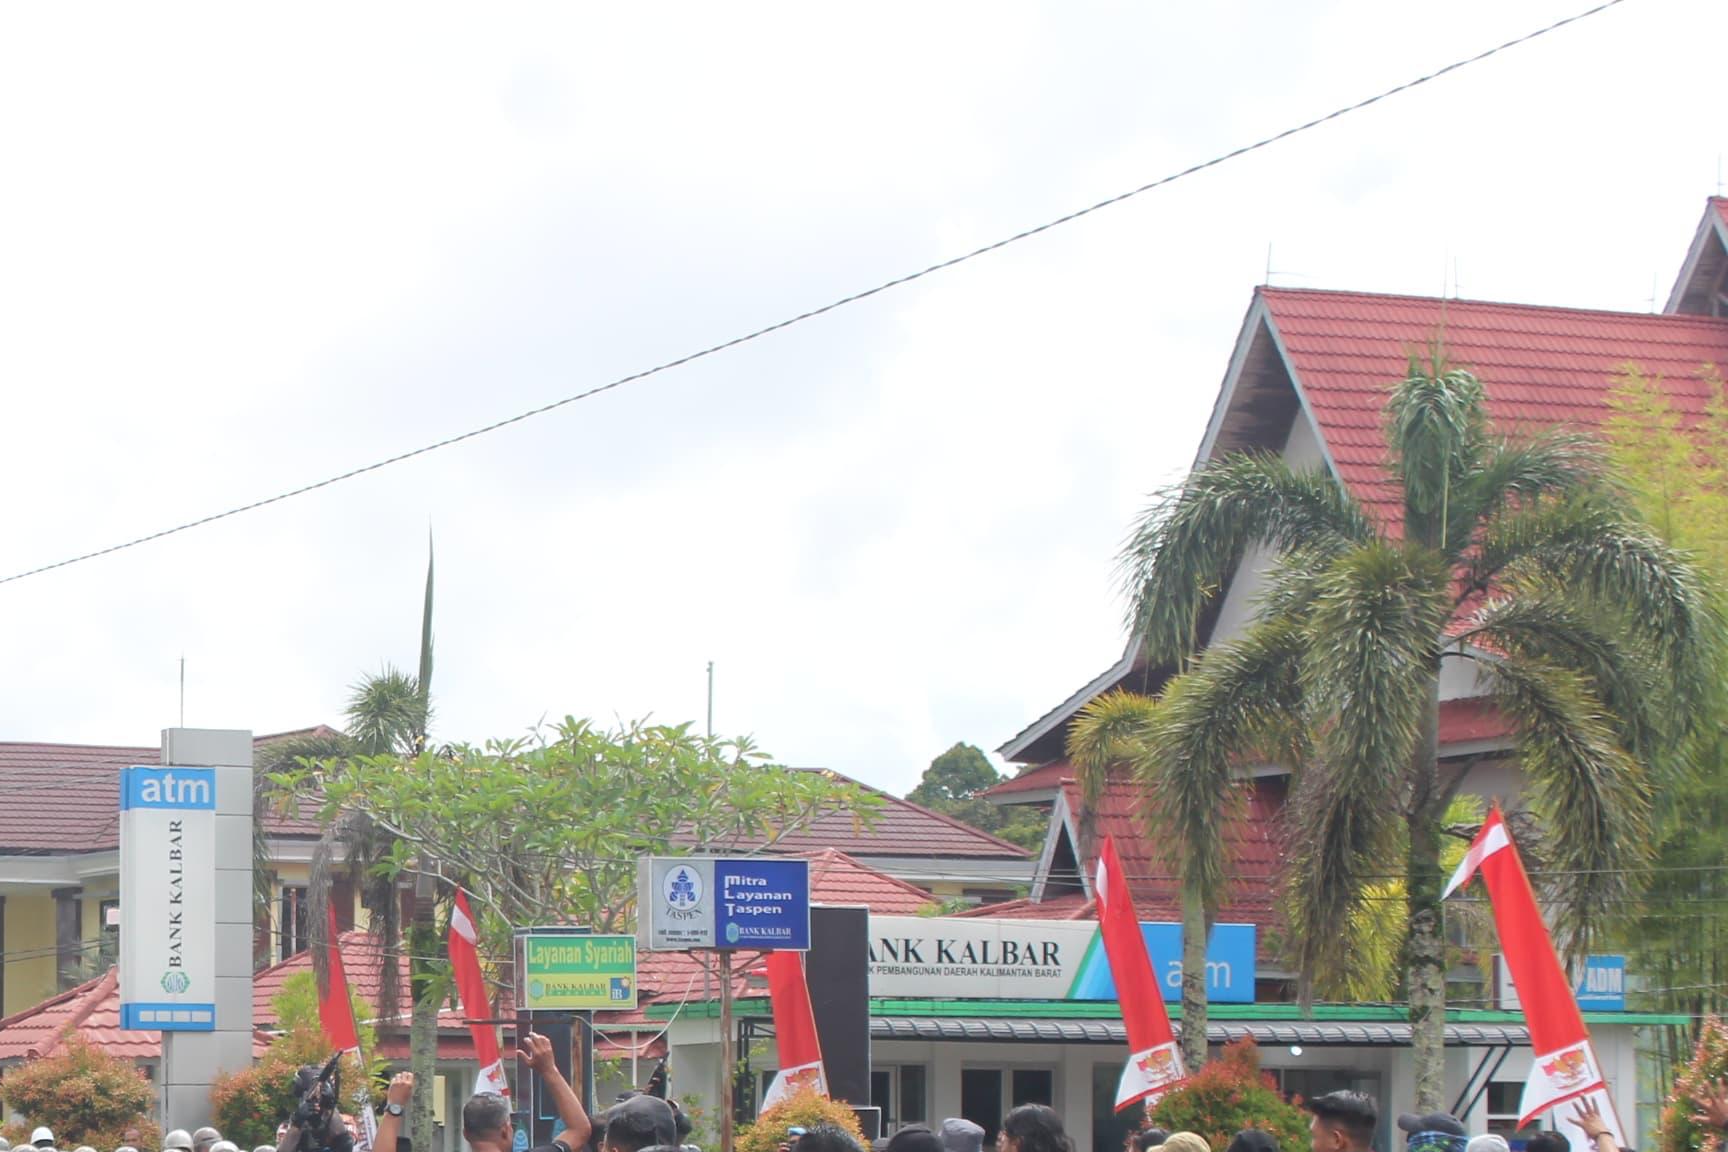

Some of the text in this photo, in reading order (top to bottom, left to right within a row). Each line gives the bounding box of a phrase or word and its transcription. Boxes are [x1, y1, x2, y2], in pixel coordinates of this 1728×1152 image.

[140, 773, 210, 803] atm
[724, 875, 767, 888] Mitra
[169, 819, 183, 967] BANK KALBAR
[724, 887, 792, 901] Layanan
[665, 906, 703, 921] TASPEN
[725, 903, 782, 917] Taspen
[529, 940, 632, 970] Layanan Syariah
[936, 939, 1061, 966] KALBAR
[877, 966, 942, 976] PEMBANGUNAN
[944, 967, 978, 977] DAERAH
[980, 968, 1033, 978] KALIMANTAN
[1035, 969, 1062, 978] BARAT
[1167, 959, 1231, 988] am
